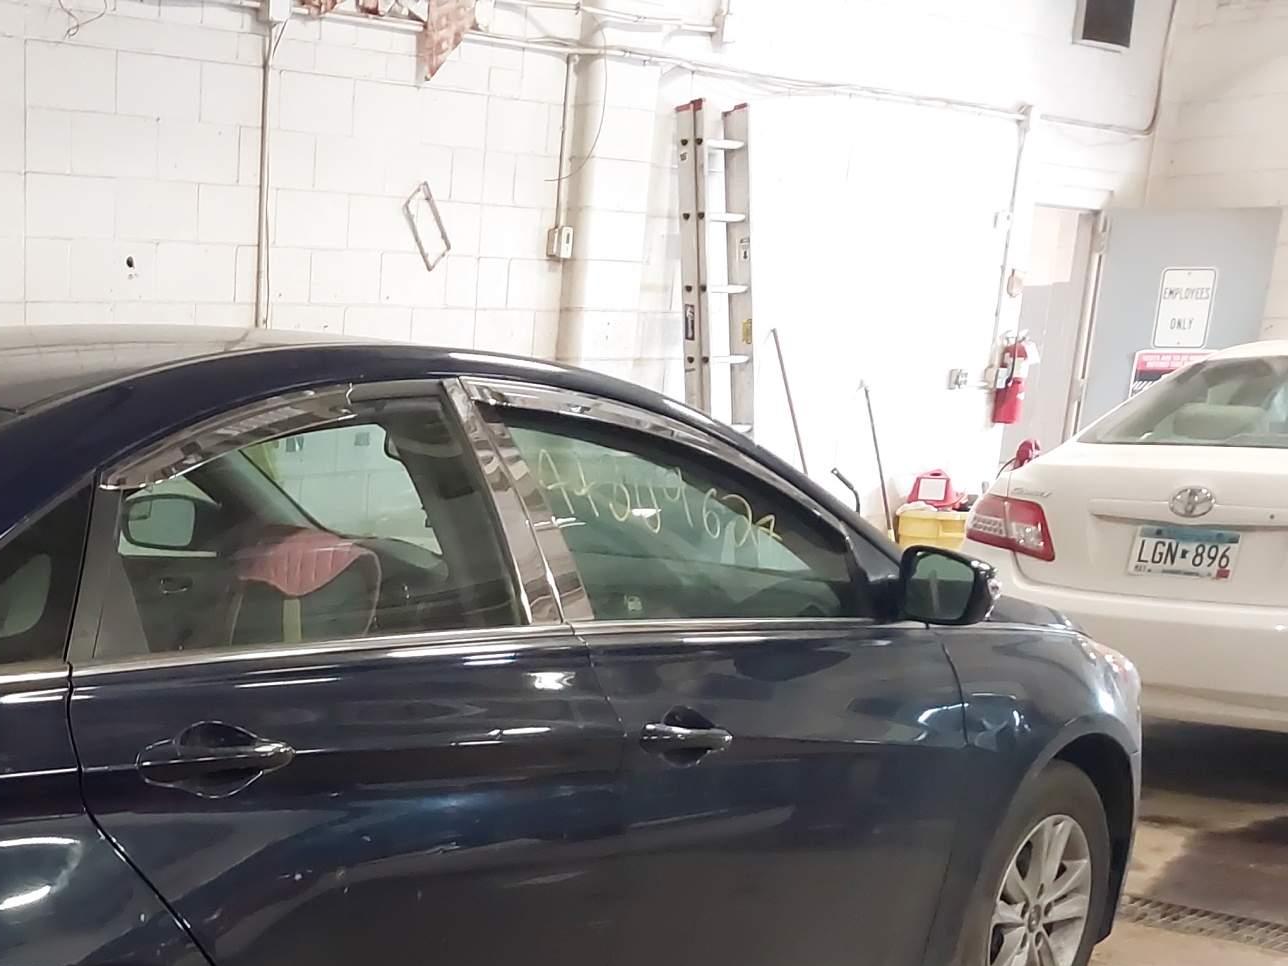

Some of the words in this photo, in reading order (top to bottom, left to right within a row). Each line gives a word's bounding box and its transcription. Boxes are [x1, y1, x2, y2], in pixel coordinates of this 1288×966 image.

[1163, 287, 1210, 300] EMPLOYEES
[1169, 317, 1194, 330] ONLY
[1137, 539, 1180, 566] LGN
[1191, 543, 1232, 569] 896
